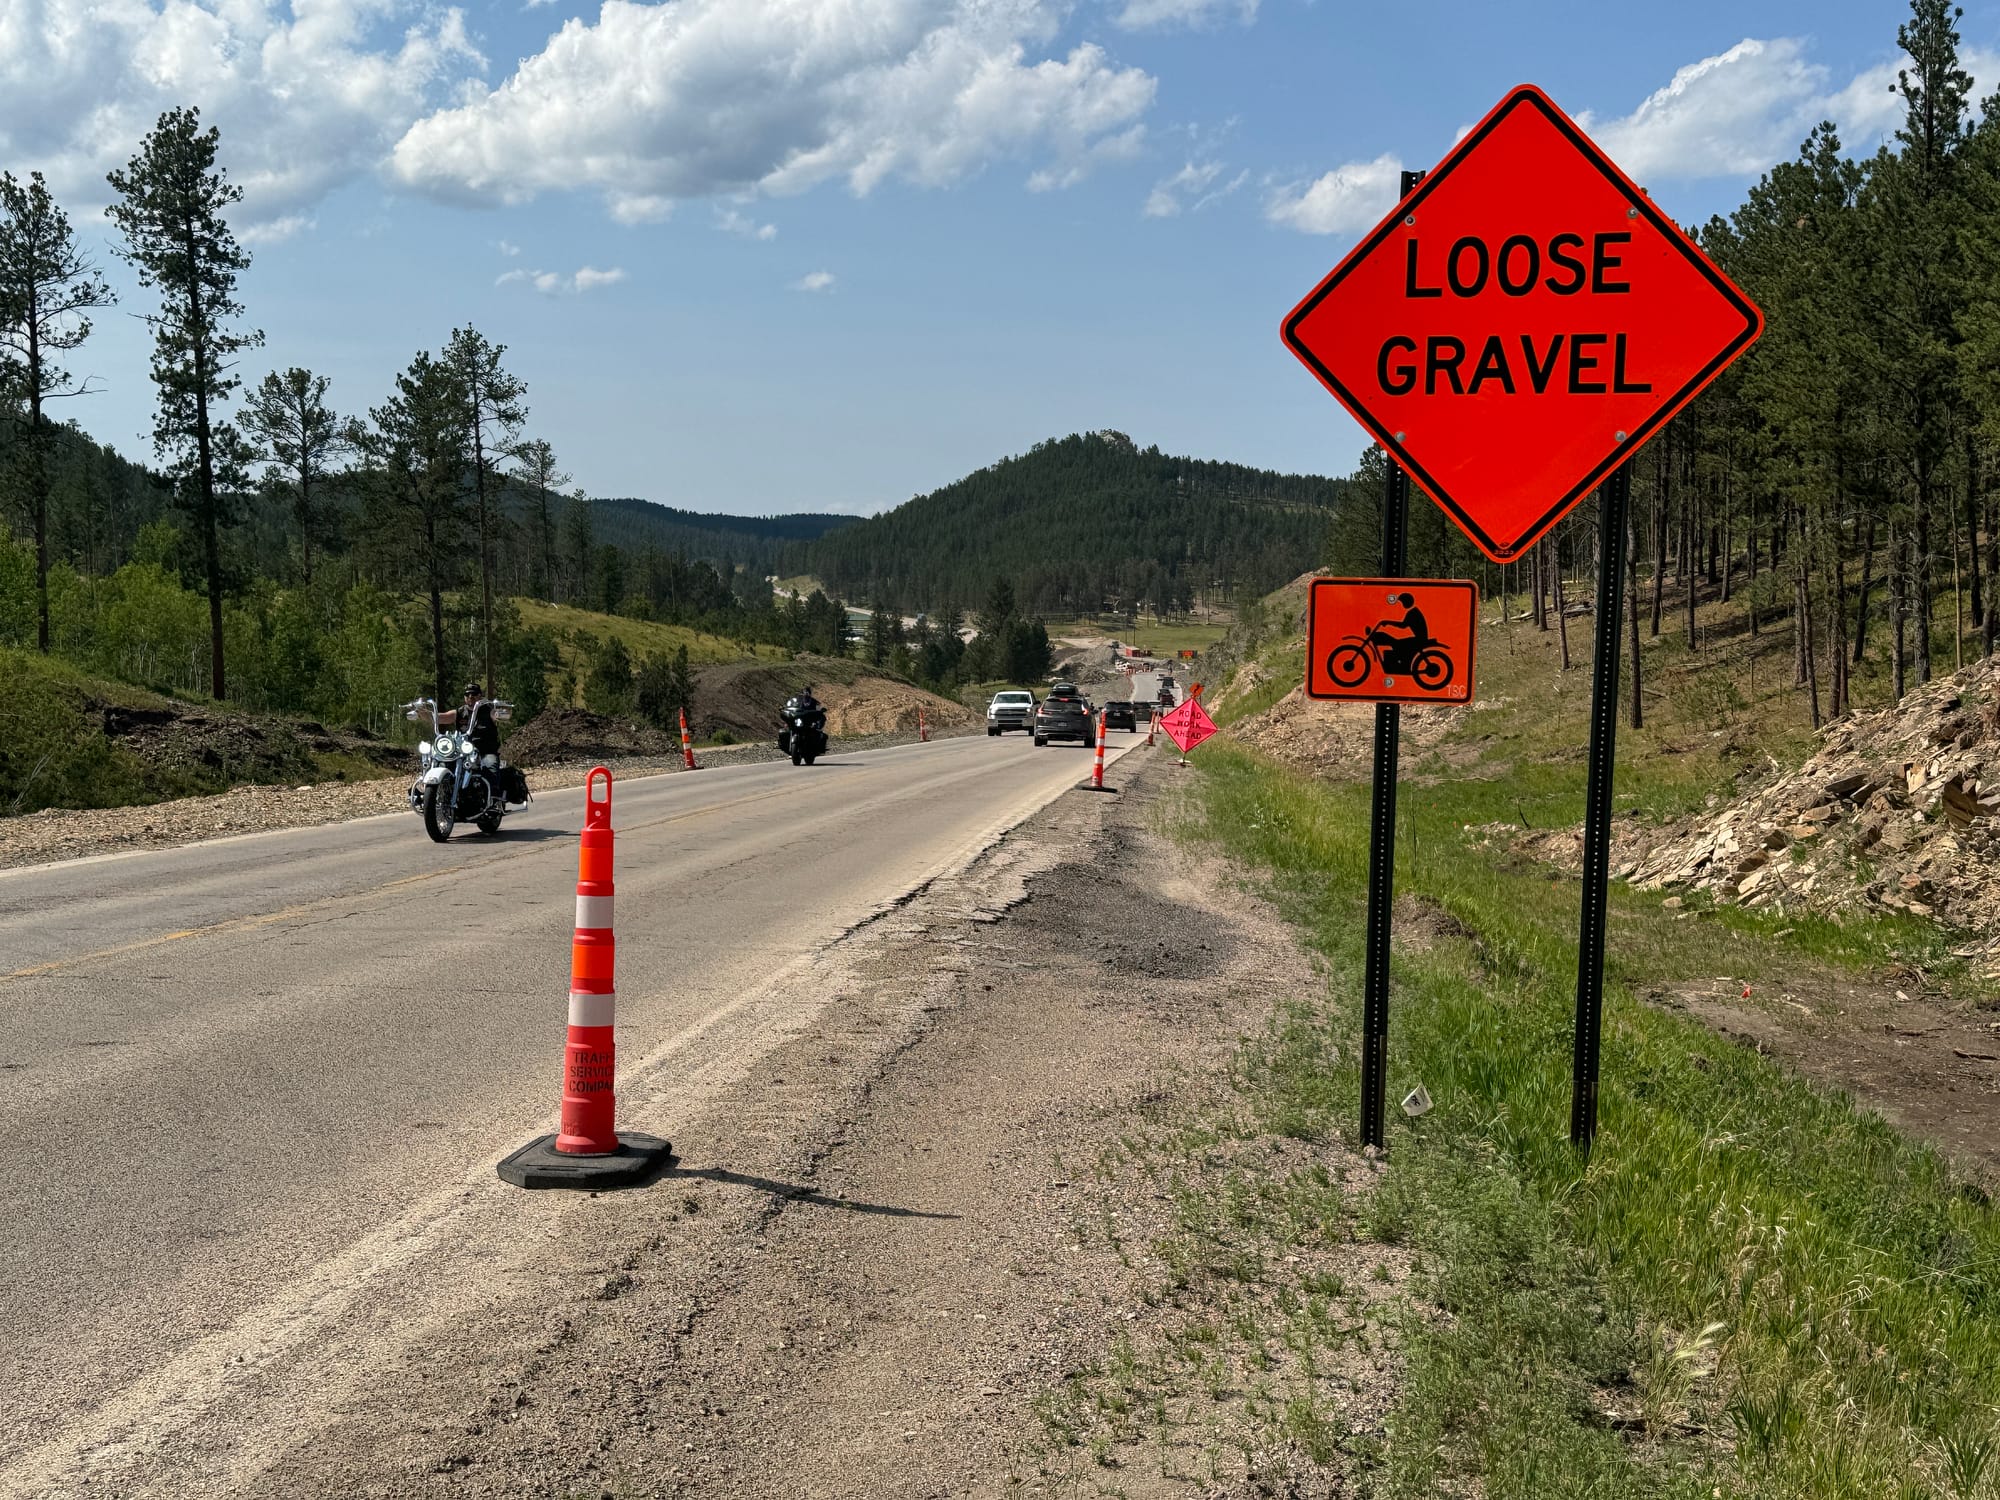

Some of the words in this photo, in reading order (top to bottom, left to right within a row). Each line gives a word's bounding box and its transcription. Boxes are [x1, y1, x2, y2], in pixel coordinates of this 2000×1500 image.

[1405, 232, 1632, 298] LOOSE
[1376, 333, 1652, 396] GRAVEL
[1179, 710, 1202, 719] ROAD
[1177, 720, 1201, 729] WORK
[1174, 730, 1202, 739] AHEAD
